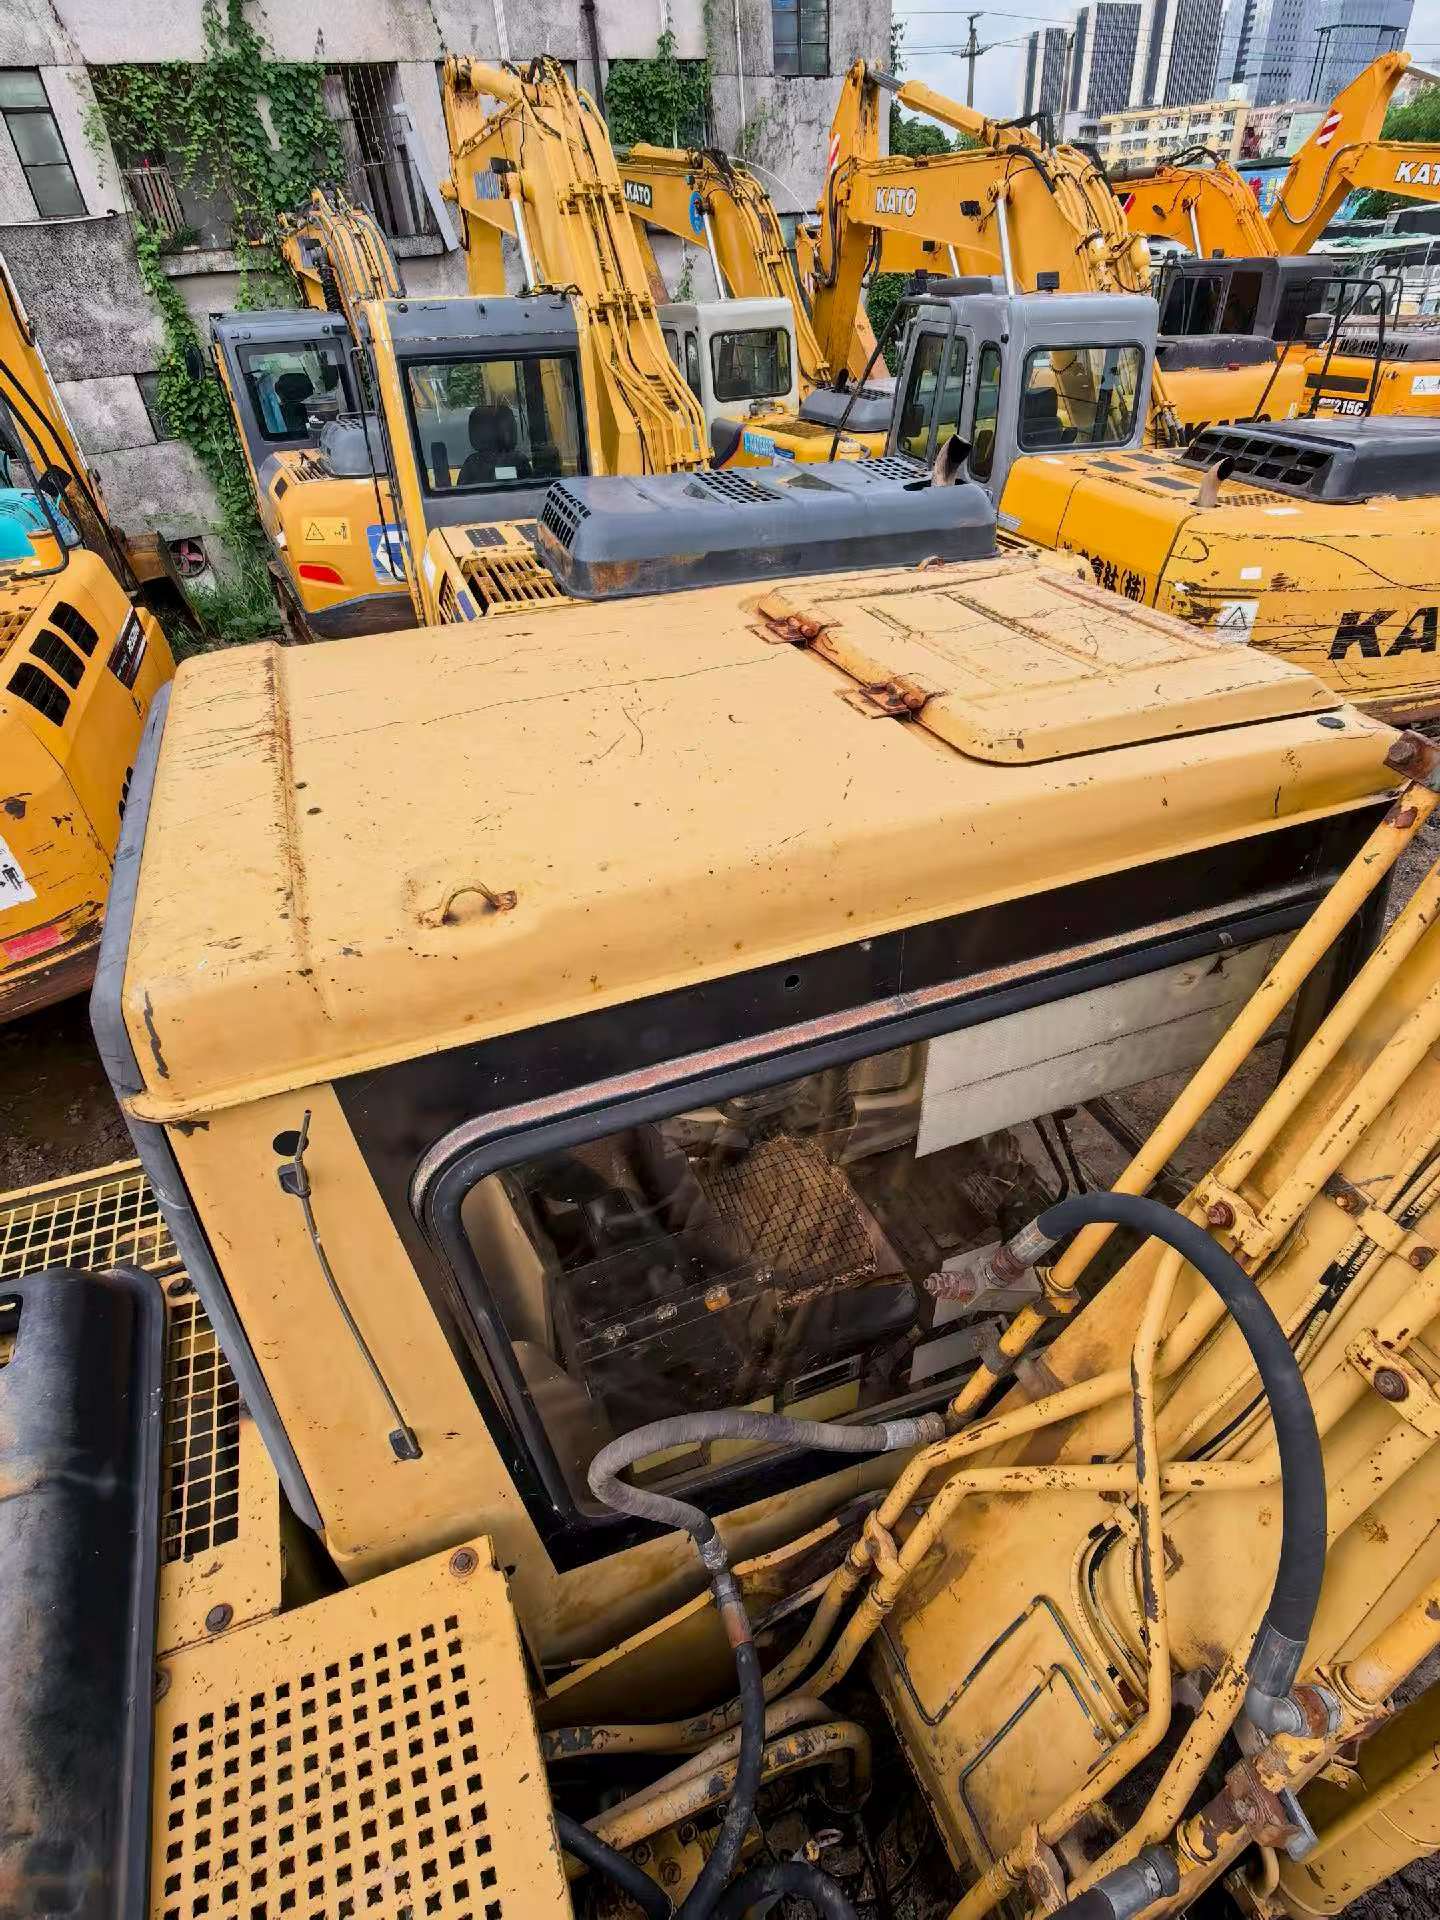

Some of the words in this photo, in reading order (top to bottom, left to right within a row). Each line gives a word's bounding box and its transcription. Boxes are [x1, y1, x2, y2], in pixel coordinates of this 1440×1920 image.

[626, 181, 652, 205] KATO
[875, 186, 917, 217] KATO
[1328, 606, 1439, 660] KA
